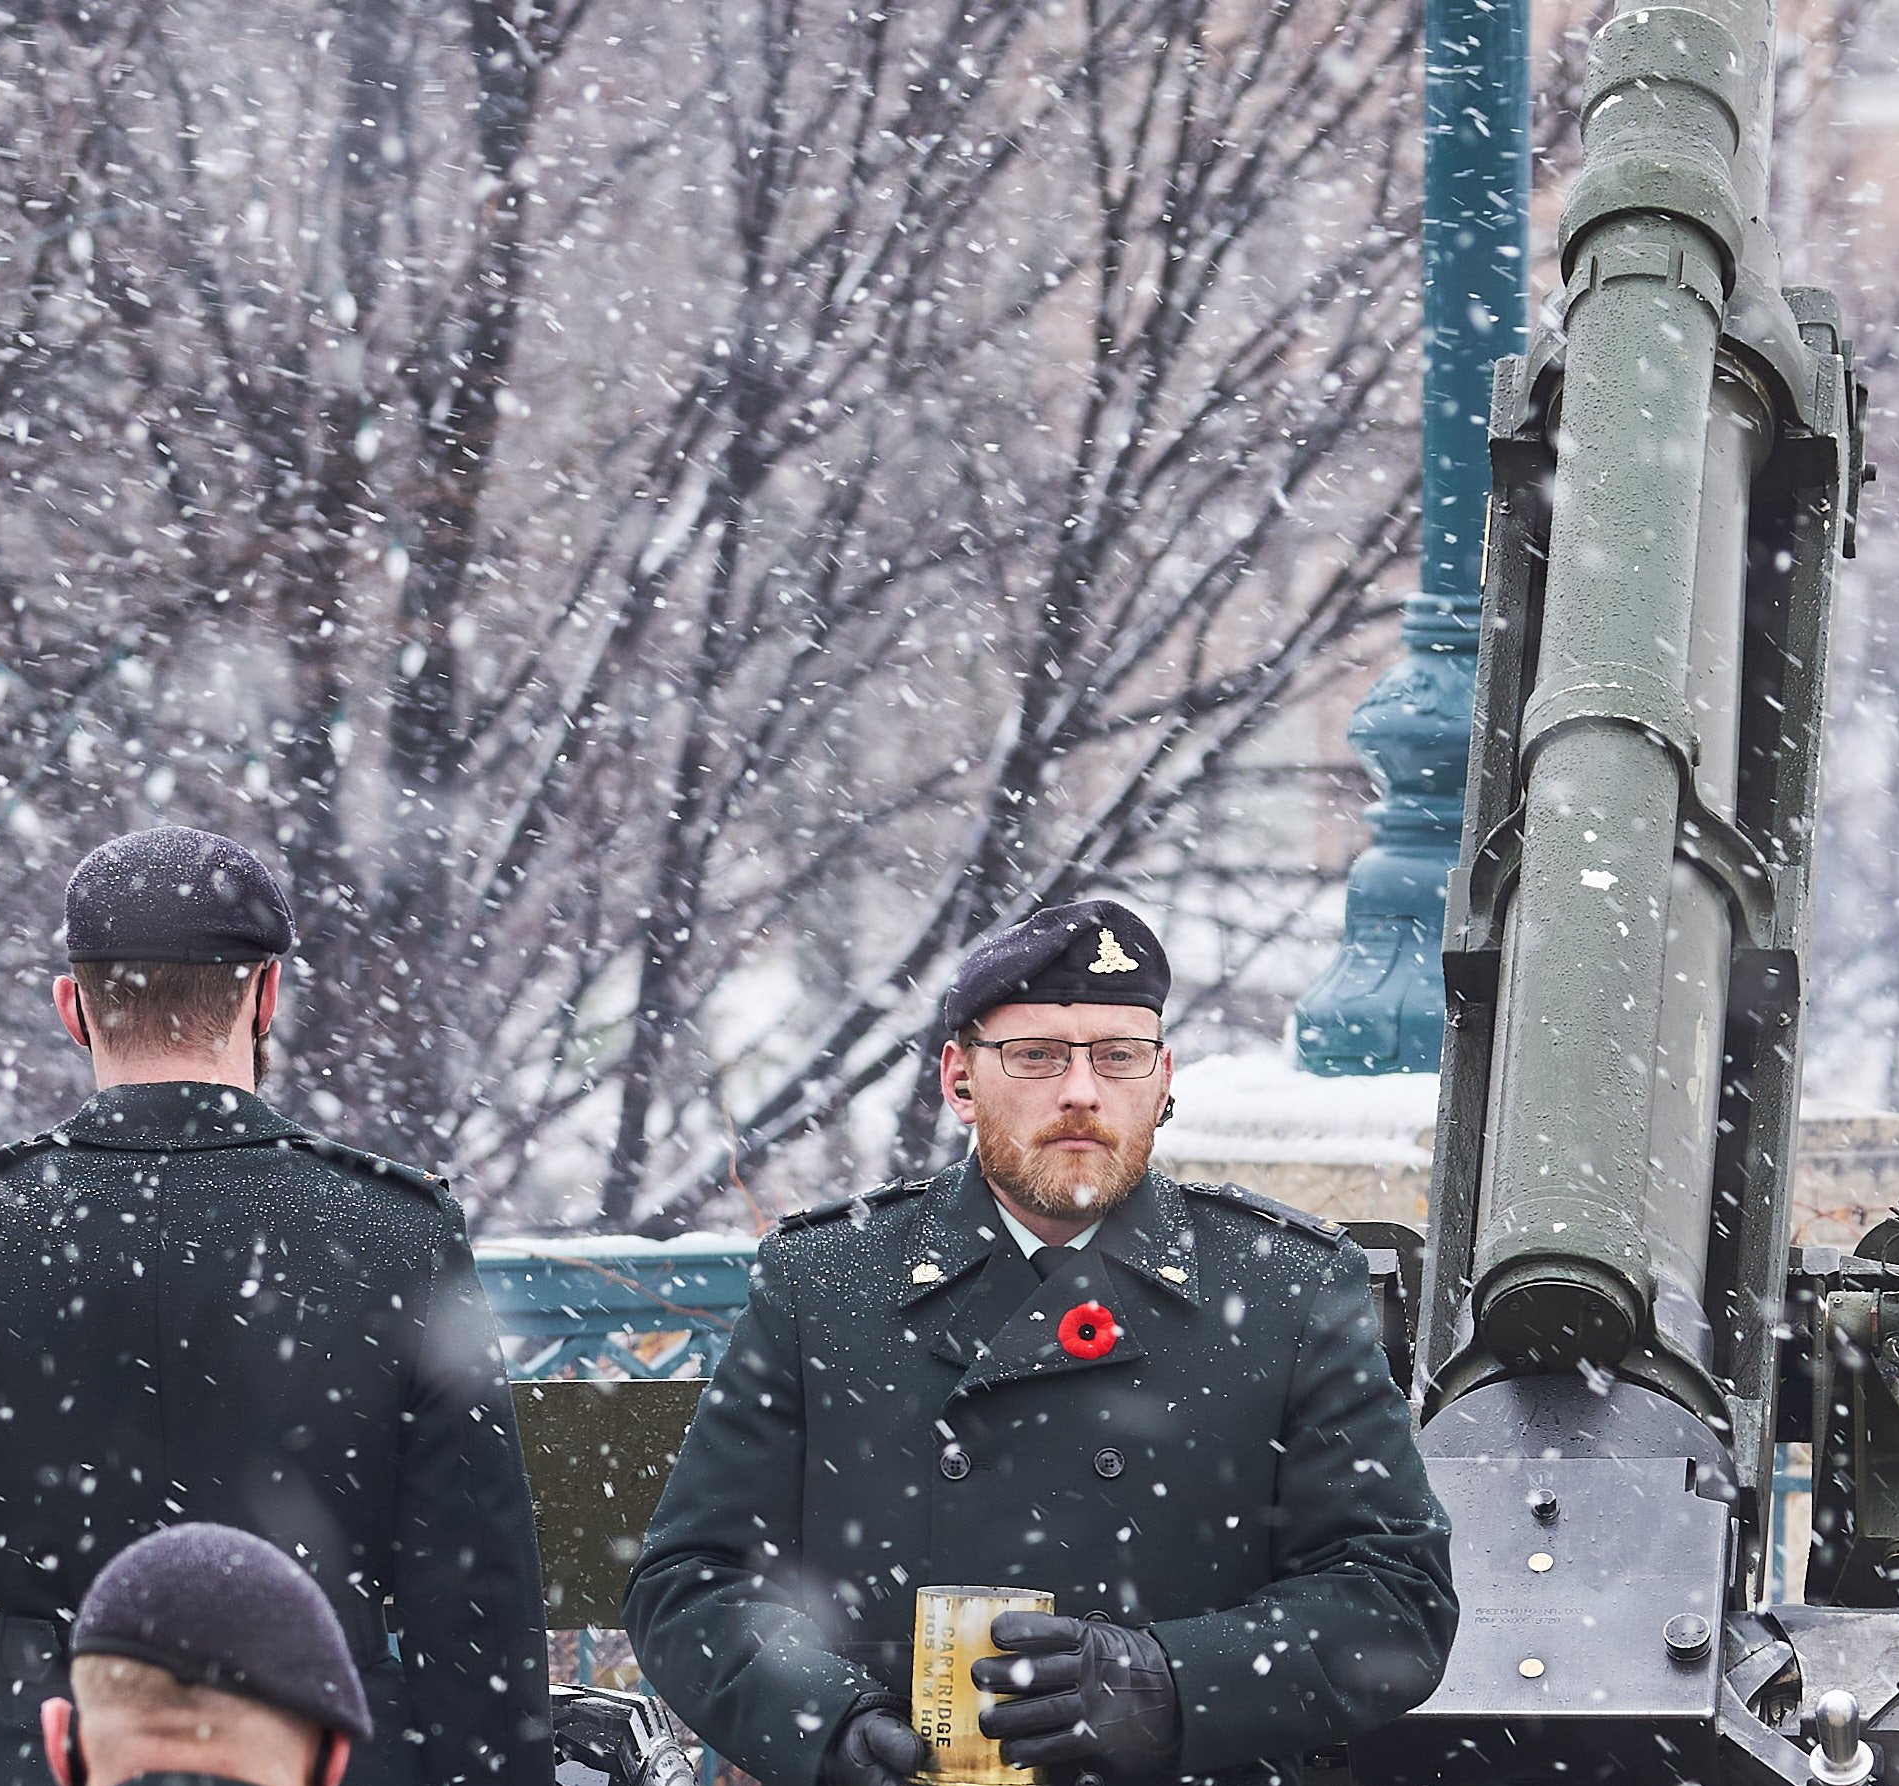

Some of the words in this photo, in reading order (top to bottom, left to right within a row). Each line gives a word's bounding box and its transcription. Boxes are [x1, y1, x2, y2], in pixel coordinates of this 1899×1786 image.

[924, 1613, 936, 1650] 105
[922, 1661, 934, 1699] MM
[936, 1627, 955, 1748] CARTRIDGE
[920, 1709, 933, 1747] HO
